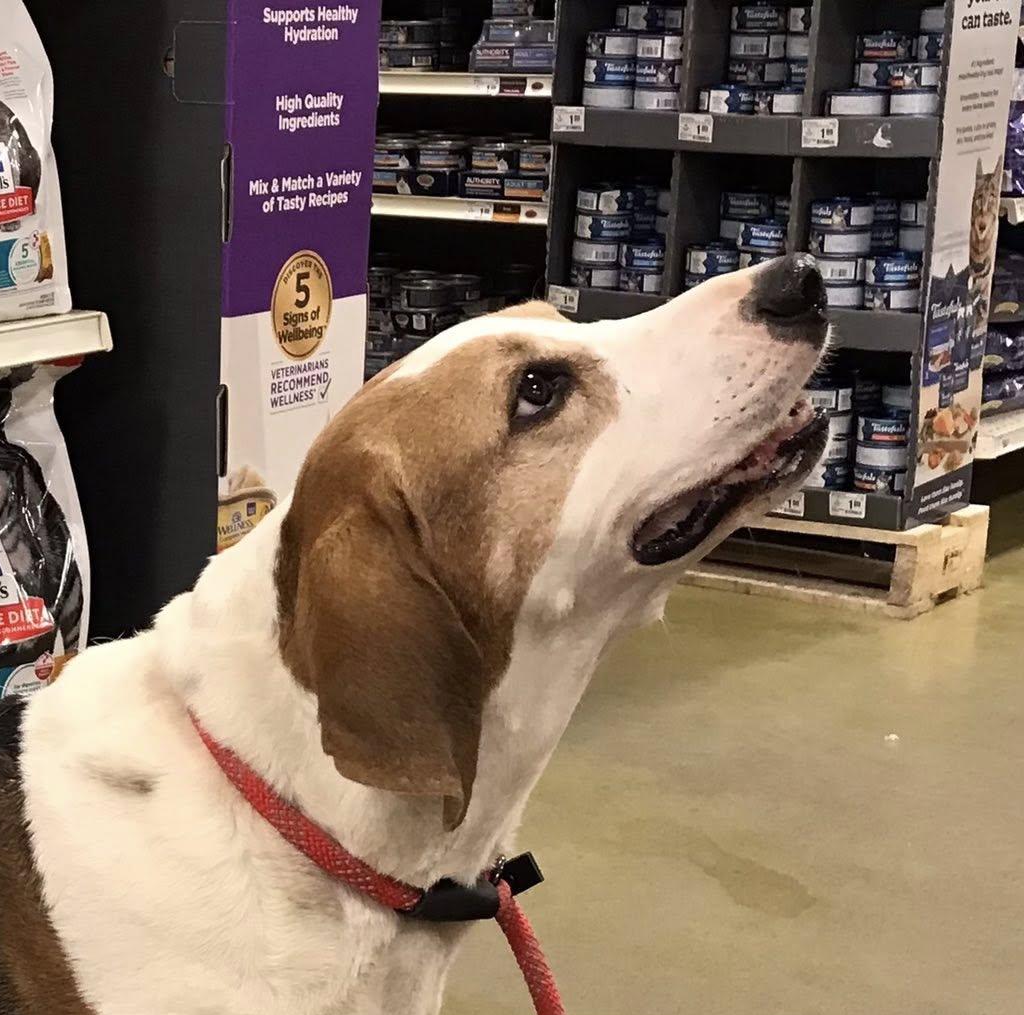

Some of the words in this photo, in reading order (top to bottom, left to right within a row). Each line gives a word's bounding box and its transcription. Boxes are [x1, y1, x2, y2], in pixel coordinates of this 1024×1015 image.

[263, 7, 315, 25] Supports
[317, 5, 358, 24] Healthy
[961, 14, 980, 30] can
[983, 10, 1012, 28] taste.
[284, 25, 339, 44] Hydration
[276, 95, 302, 113] High
[305, 92, 344, 109] Quality
[278, 112, 340, 132] Ingredients
[249, 180, 268, 196] Mix
[271, 178, 279, 193] &
[282, 174, 315, 191] Match
[316, 177, 323, 188] a
[325, 170, 362, 186] Variety
[467, 177, 500, 185] AUTHORITY
[8, 195, 29, 208] DIET
[262, 198, 275, 213] of
[276, 196, 306, 212] Tasty
[308, 190, 348, 207] Recipes
[21, 243, 29, 259] 5
[283, 260, 313, 284] DISCOVER
[294, 271, 310, 309] 5
[283, 311, 309, 327] Signs
[310, 305, 321, 320] of
[278, 325, 324, 345] Wellbeing
[271, 358, 329, 380] VETERINARIANS
[270, 371, 329, 395] RECOMMEND
[270, 389, 314, 408] WELLNESS
